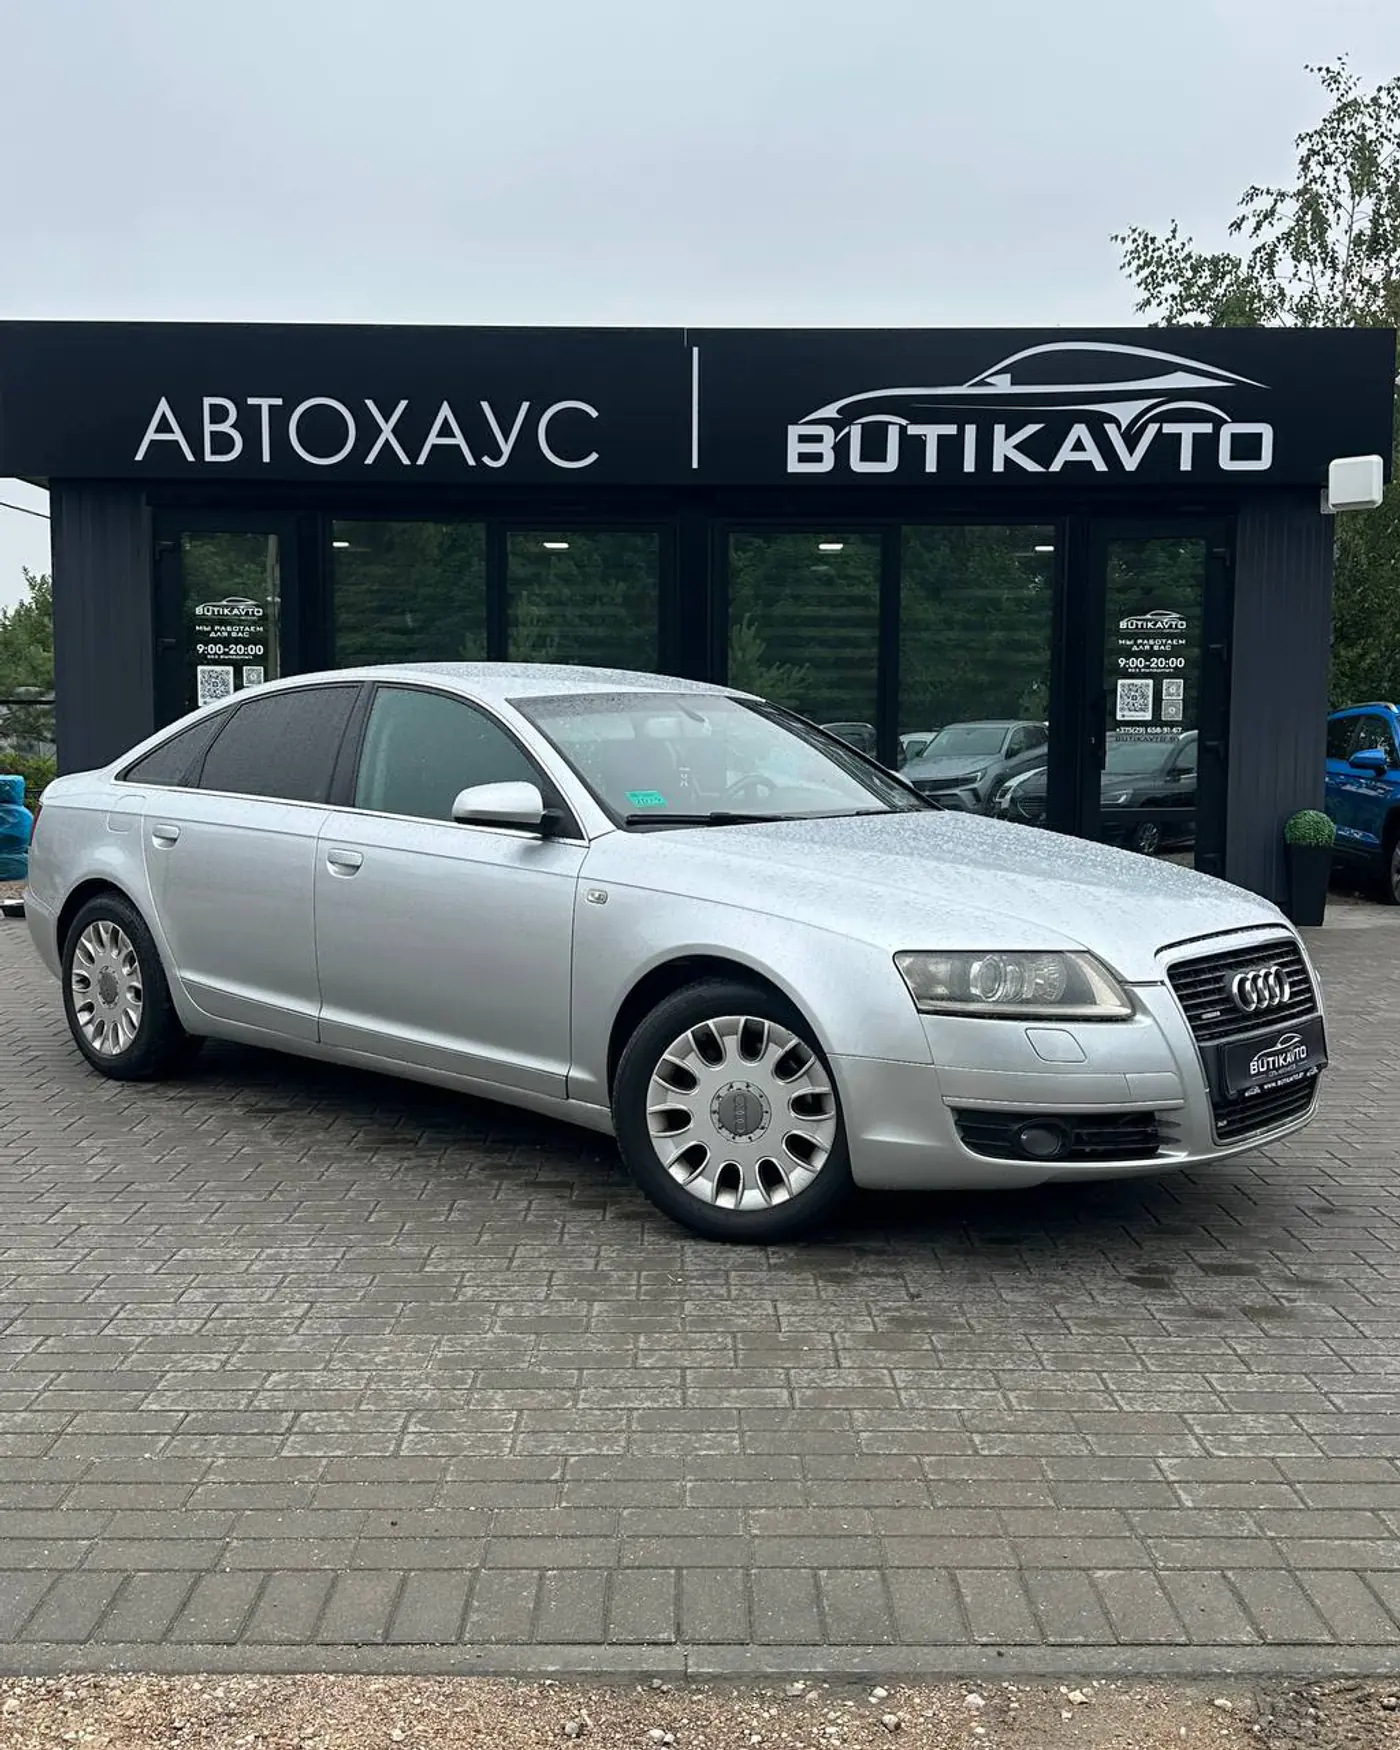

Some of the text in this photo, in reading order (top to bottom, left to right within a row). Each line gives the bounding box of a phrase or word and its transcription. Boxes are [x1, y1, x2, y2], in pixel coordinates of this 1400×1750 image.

[134, 396, 600, 469] АВТОХАУС
[786, 422, 1274, 473] BUTIKAVTO
[195, 606, 263, 616] BUTIKAVTO
[1119, 620, 1187, 629] BUTIKAVTO
[196, 644, 264, 655] 9:00-20:00
[1118, 657, 1185, 668] 9:00-20:00
[1249, 1045, 1307, 1075] BUTIKAVTO
